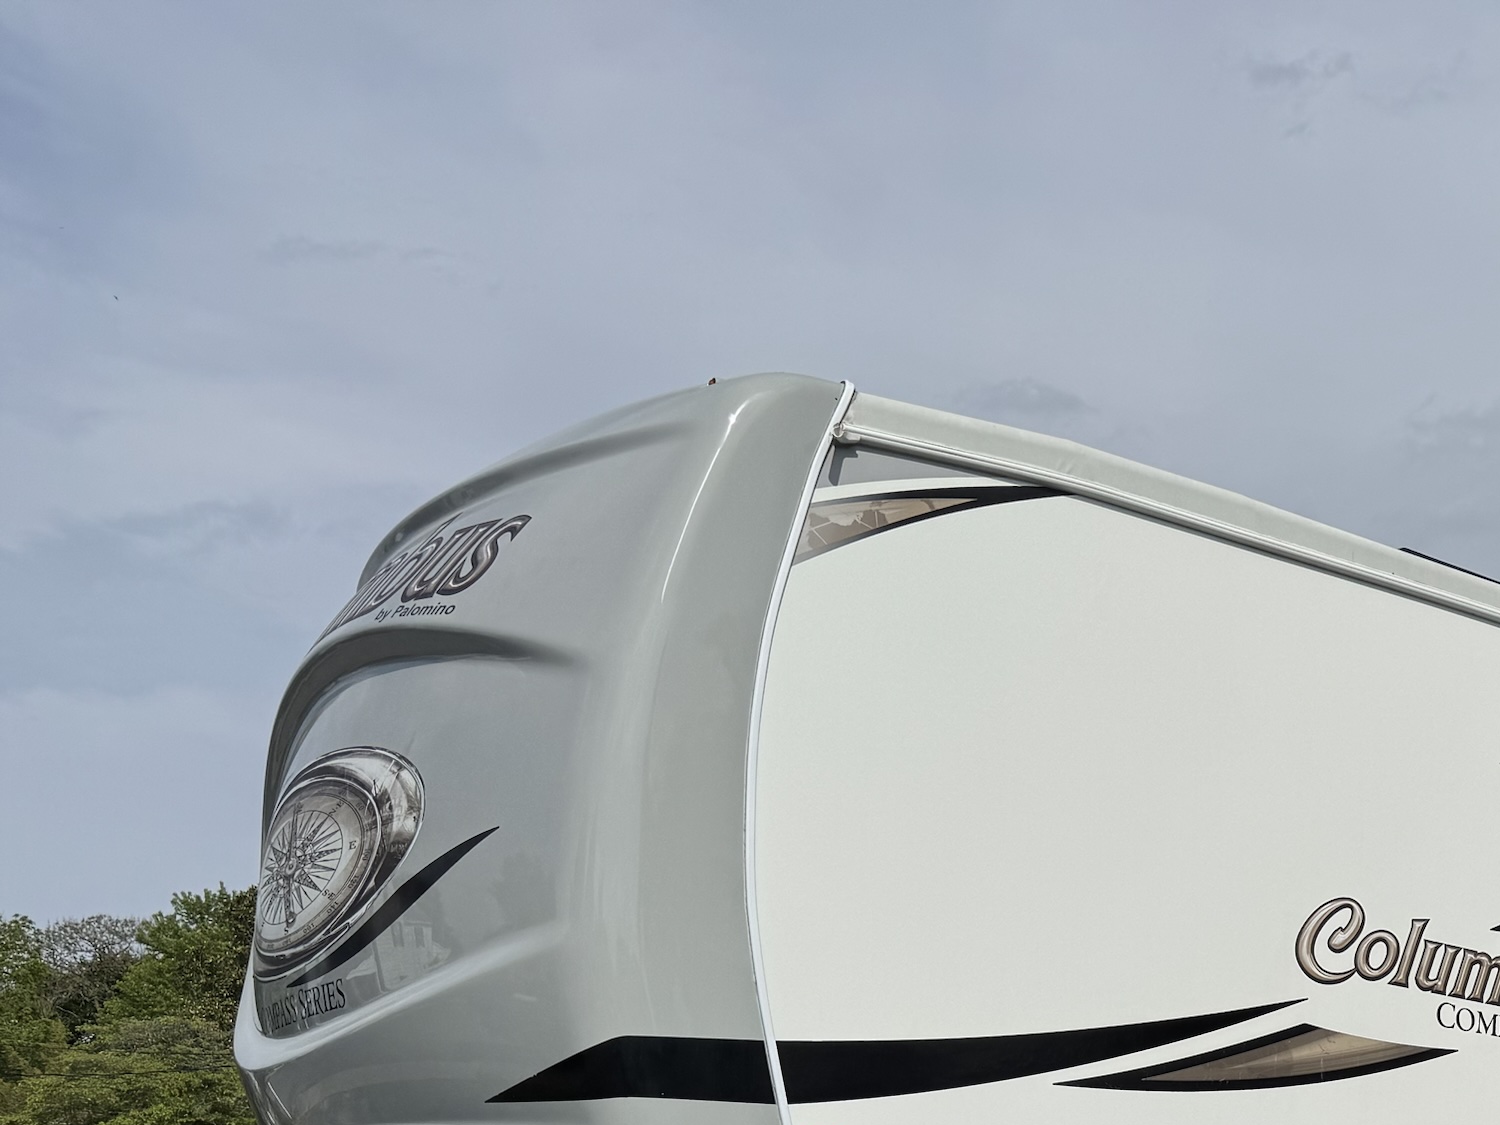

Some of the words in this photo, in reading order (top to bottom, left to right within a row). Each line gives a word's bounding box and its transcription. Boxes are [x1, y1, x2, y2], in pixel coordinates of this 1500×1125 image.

[374, 607, 392, 623] by
[391, 602, 456, 619] Palomino
[348, 840, 357, 851] E
[298, 978, 346, 1020] SERIES
